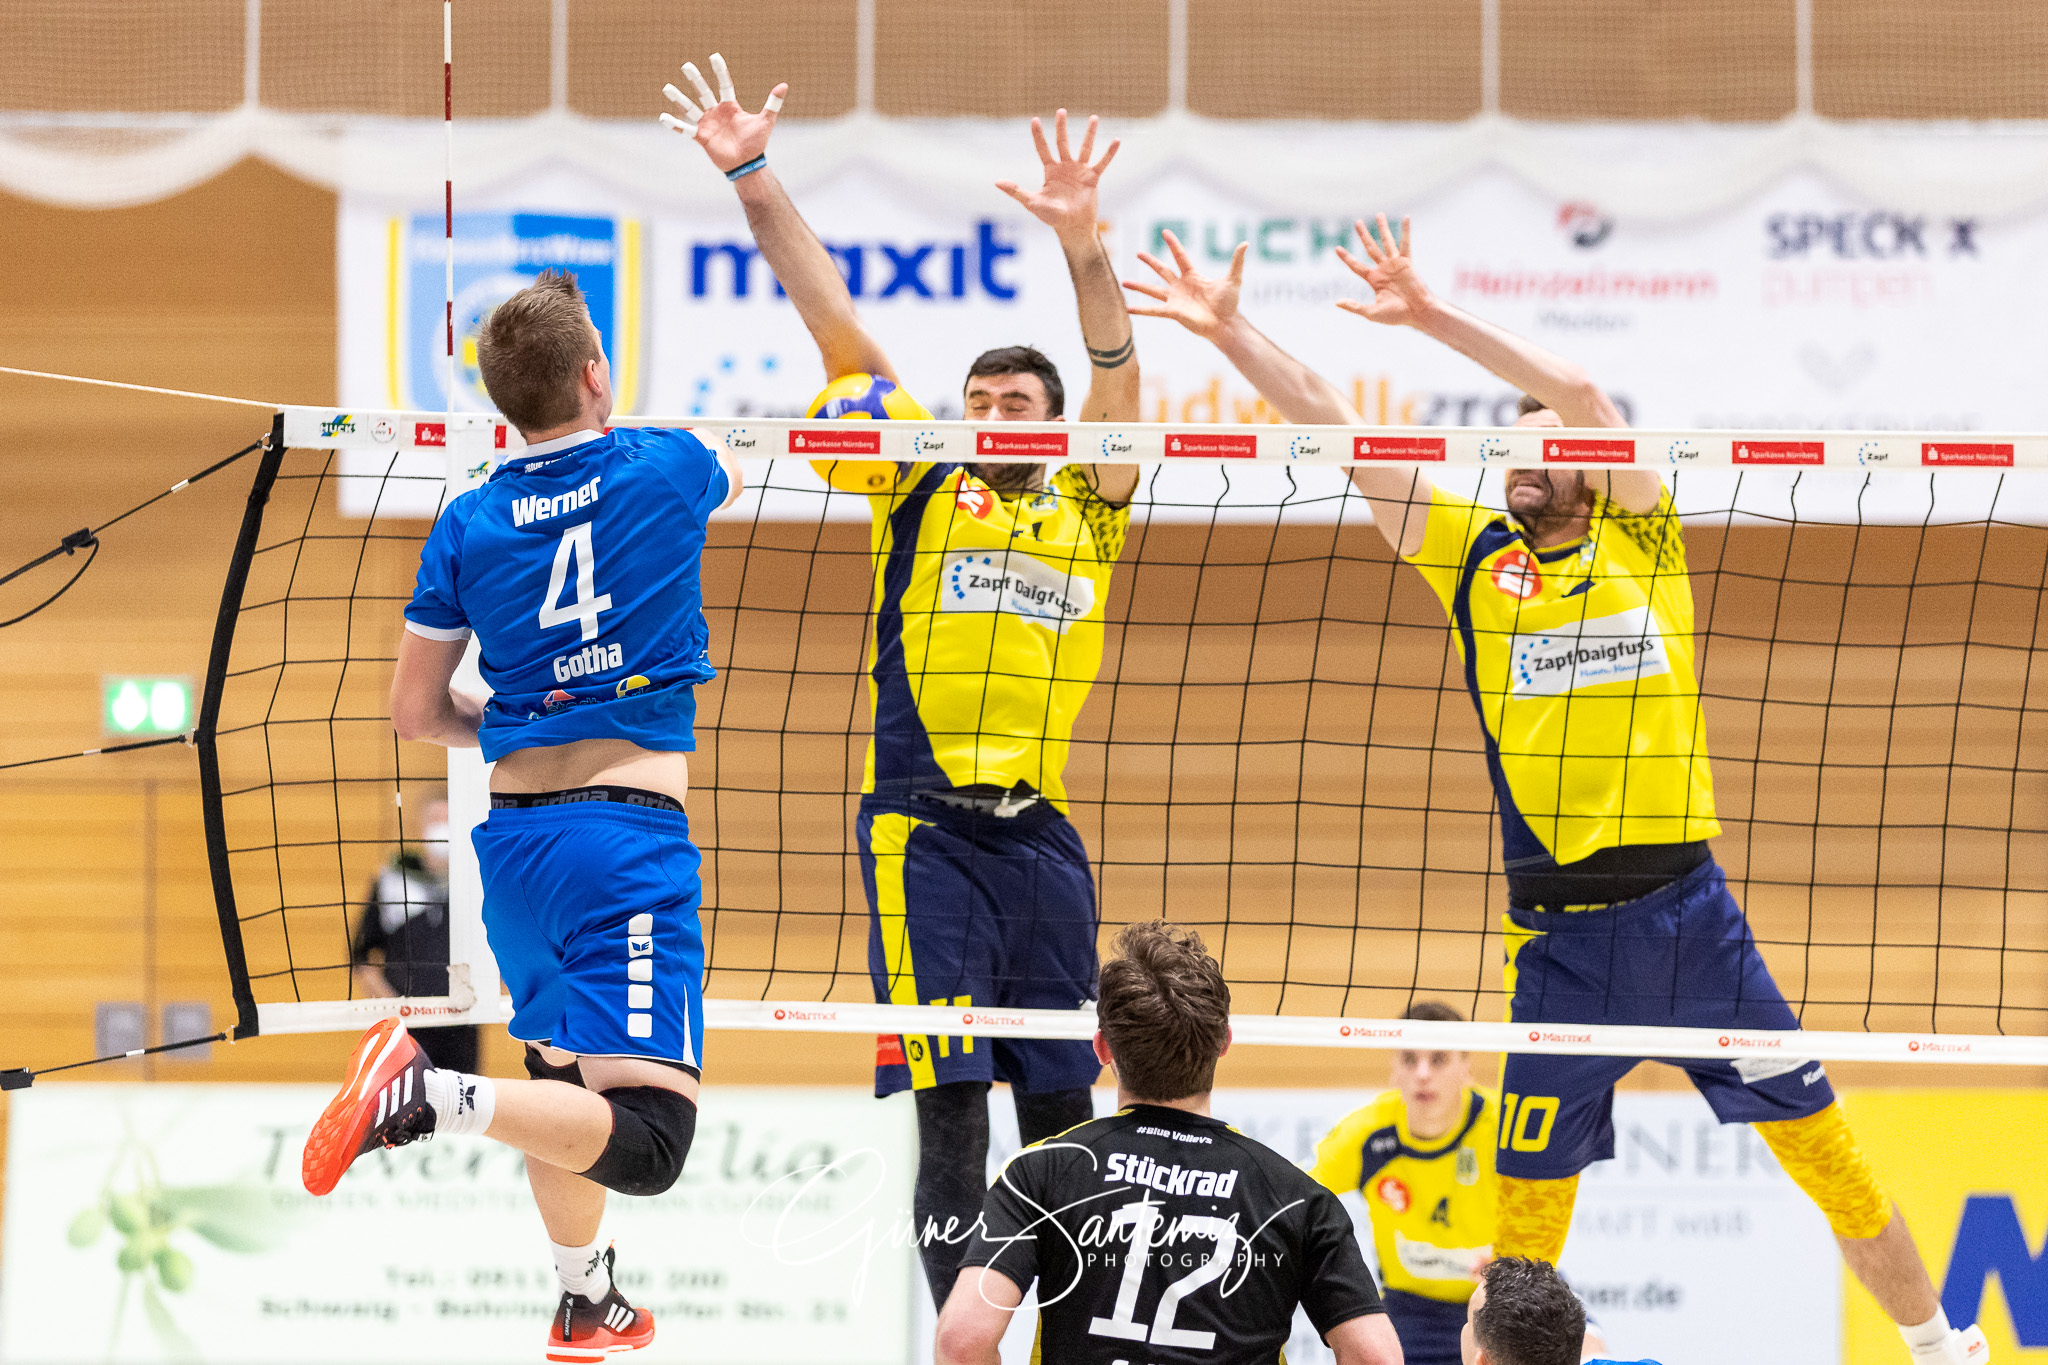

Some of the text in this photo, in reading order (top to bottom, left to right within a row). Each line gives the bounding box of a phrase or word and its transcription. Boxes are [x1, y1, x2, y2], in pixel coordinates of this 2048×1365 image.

[1766, 211, 1927, 259] SPECK
[735, 439, 756, 448] Zapf
[807, 440, 841, 449] Sparkasse
[923, 442, 944, 450] Zapf
[995, 442, 1029, 450] Sparkasse
[1111, 443, 1132, 452] Zapf
[1299, 446, 1320, 454] Zapf
[1489, 448, 1510, 457] Zapf
[1678, 451, 1699, 459] Zapf
[511, 475, 601, 528] Werner
[538, 520, 613, 642] 4
[969, 574, 1011, 591] Zapf
[1014, 579, 1083, 616] Daigfuss
[1533, 650, 1573, 672] Zapf
[1578, 637, 1654, 664] Daigfuss
[552, 642, 624, 683] Gotha
[787, 1009, 837, 1021] Marmot
[975, 1014, 1025, 1026] Marmot
[1353, 1027, 1402, 1038] Marmot
[1542, 1032, 1592, 1043] Marmot
[1498, 1091, 1561, 1152] 10
[1136, 1125, 1213, 1145] #Blue Volleys
[1103, 1152, 1239, 1199] Stückrad
[1087, 1205, 1238, 1350] 12
